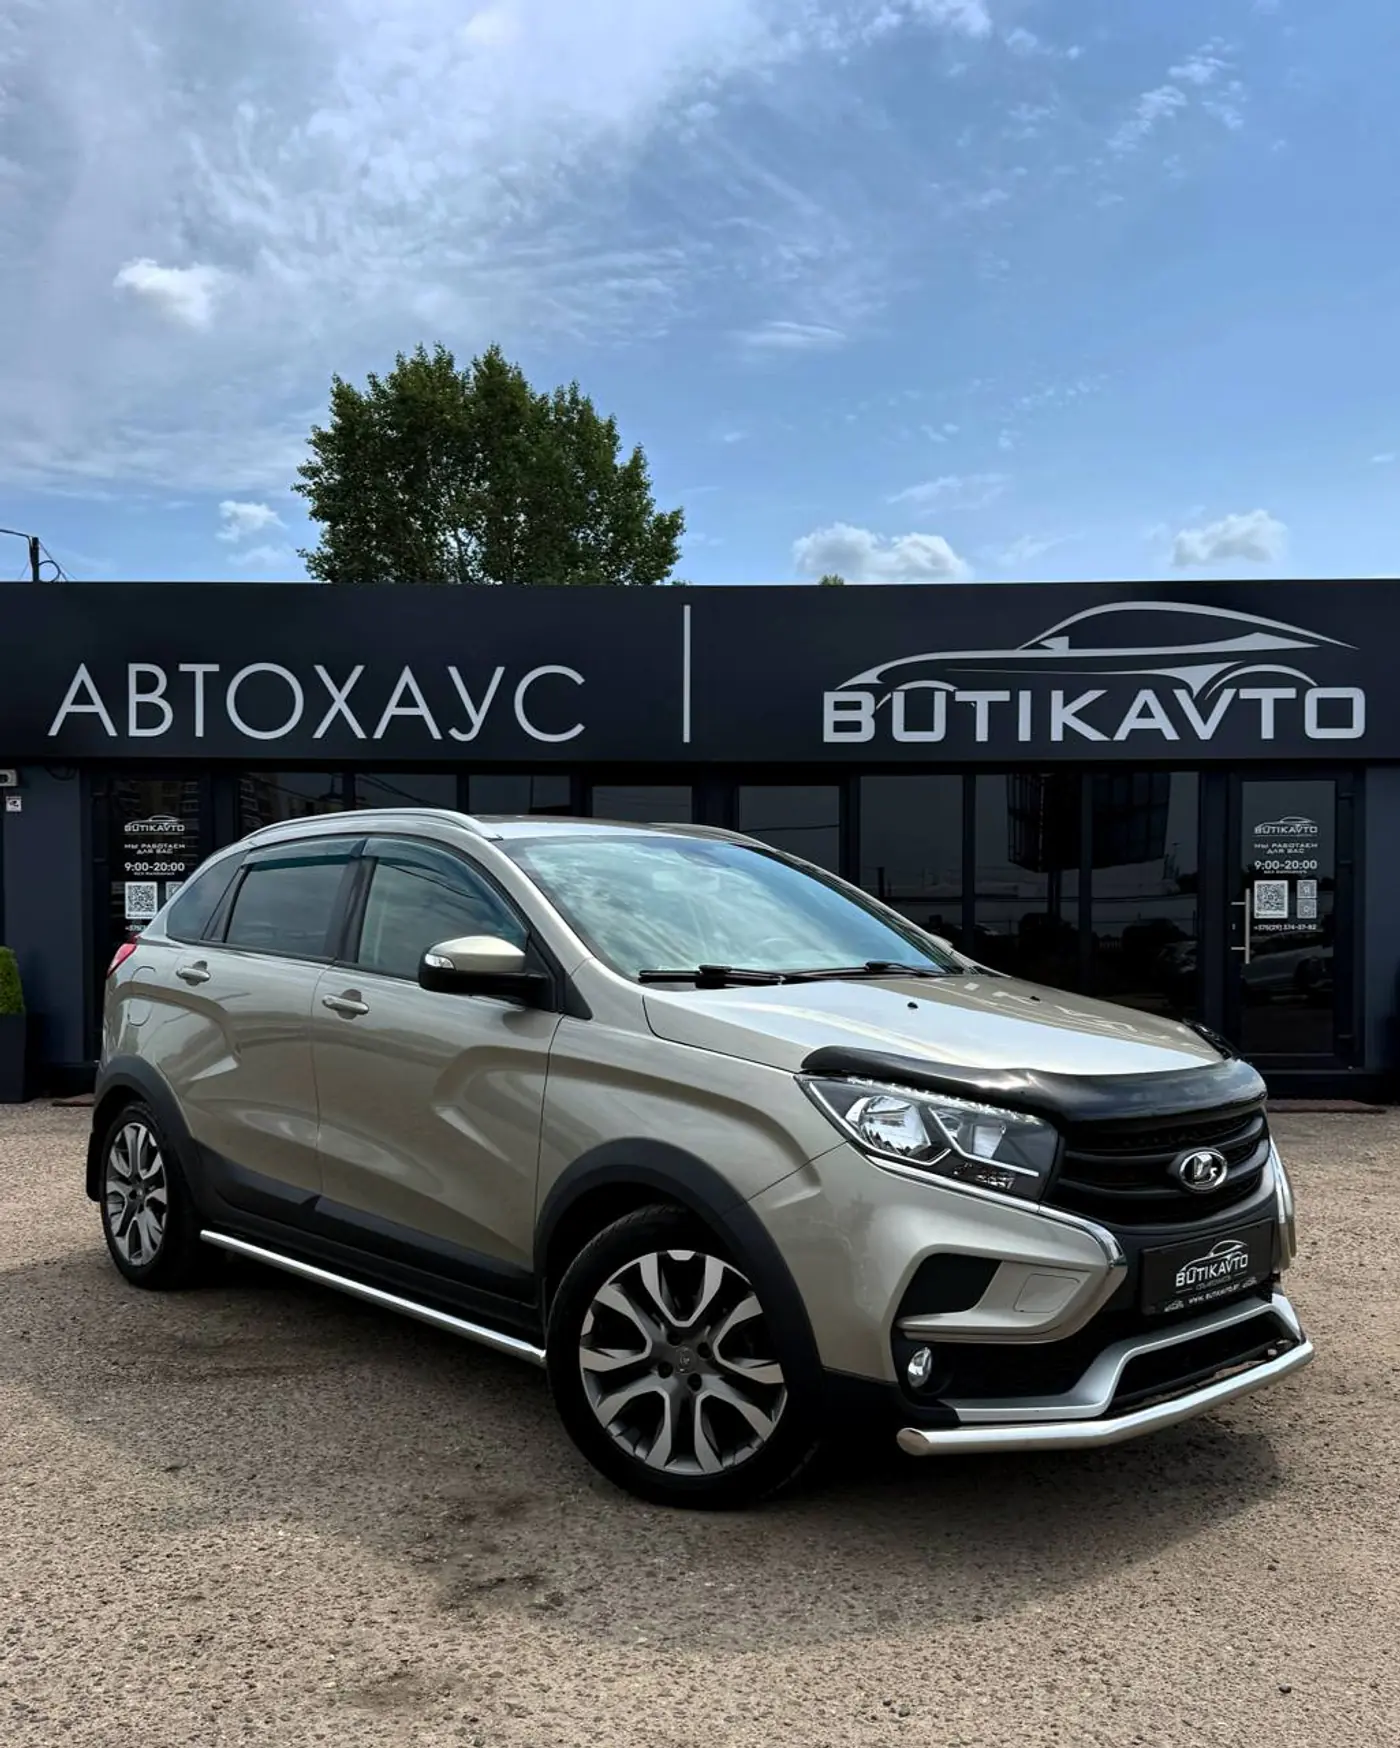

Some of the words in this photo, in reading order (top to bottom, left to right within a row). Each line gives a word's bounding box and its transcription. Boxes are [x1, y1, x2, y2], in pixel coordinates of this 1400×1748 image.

[47, 662, 586, 743] АВТОХАУС
[823, 686, 1366, 743] BUTIKAVTO
[124, 823, 185, 832] BUTIKAVTO
[1254, 826, 1318, 834] BUTIKAVTO
[124, 862, 186, 872] 9:00-20:00
[1254, 860, 1318, 870] 9:00-20:00
[1175, 1254, 1249, 1287] BUTIKAVTO
